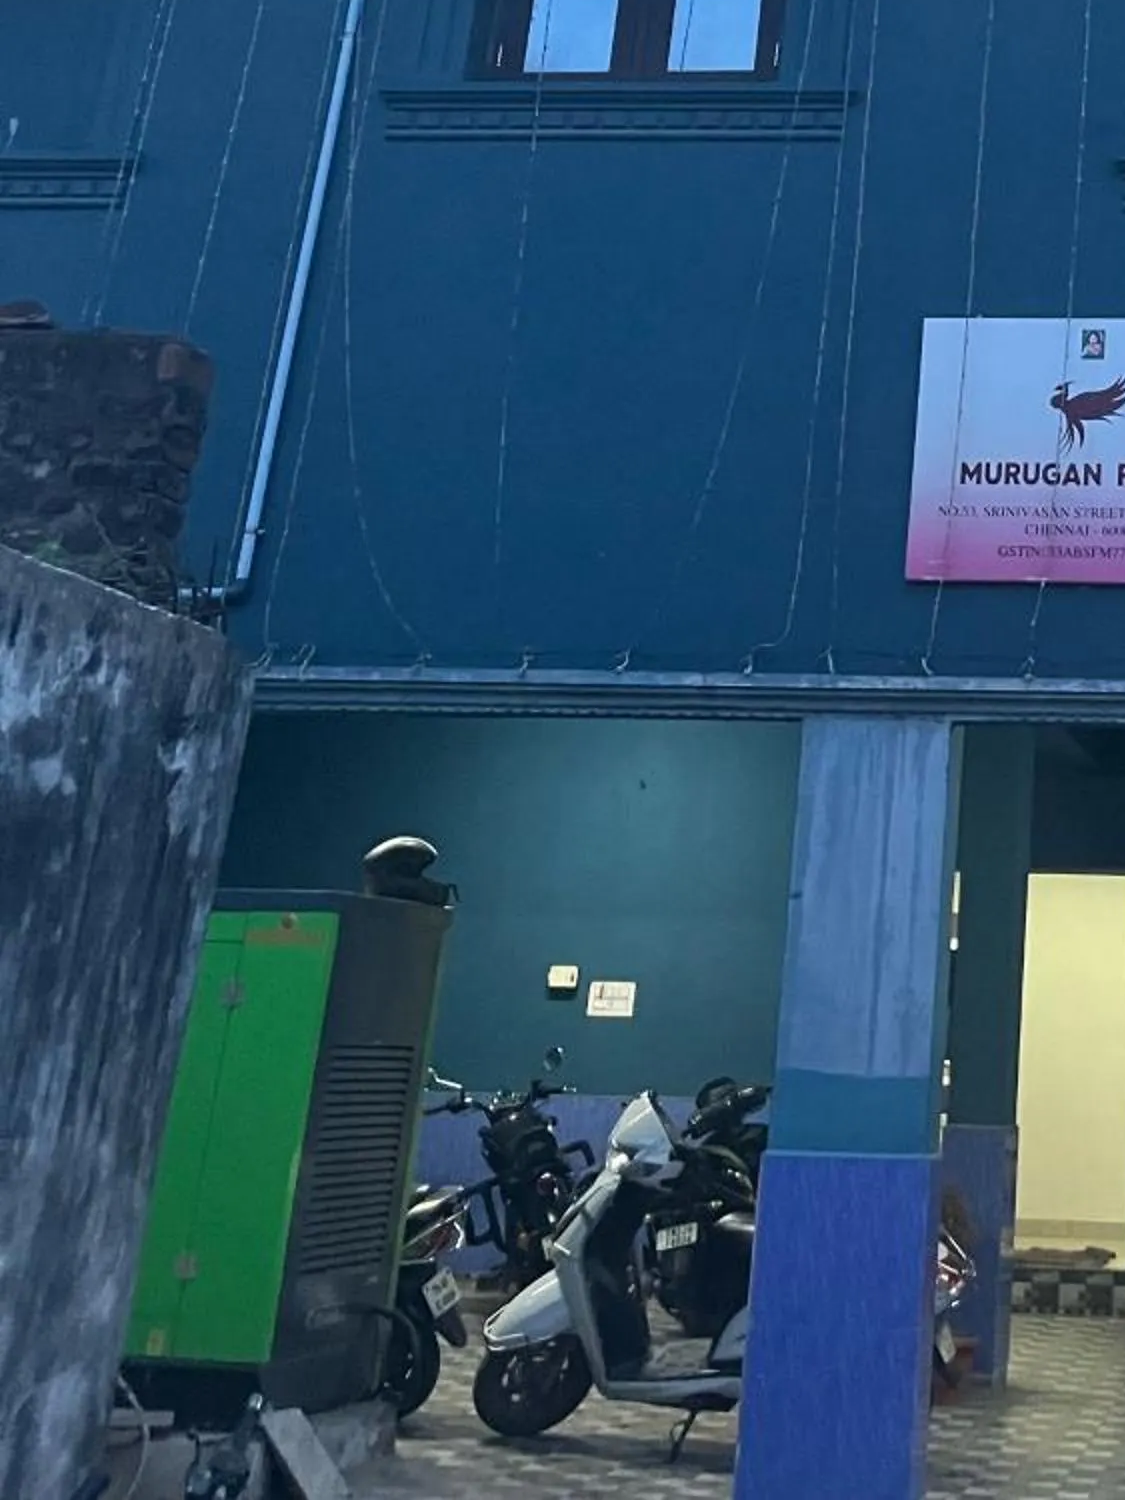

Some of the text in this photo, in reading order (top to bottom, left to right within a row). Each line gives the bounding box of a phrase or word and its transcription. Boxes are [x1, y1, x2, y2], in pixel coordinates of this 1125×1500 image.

[960, 462, 1101, 486] MURUGAN
[983, 505, 1069, 518] SRINIVASAN
[1024, 523, 1089, 536] CHENNAI
